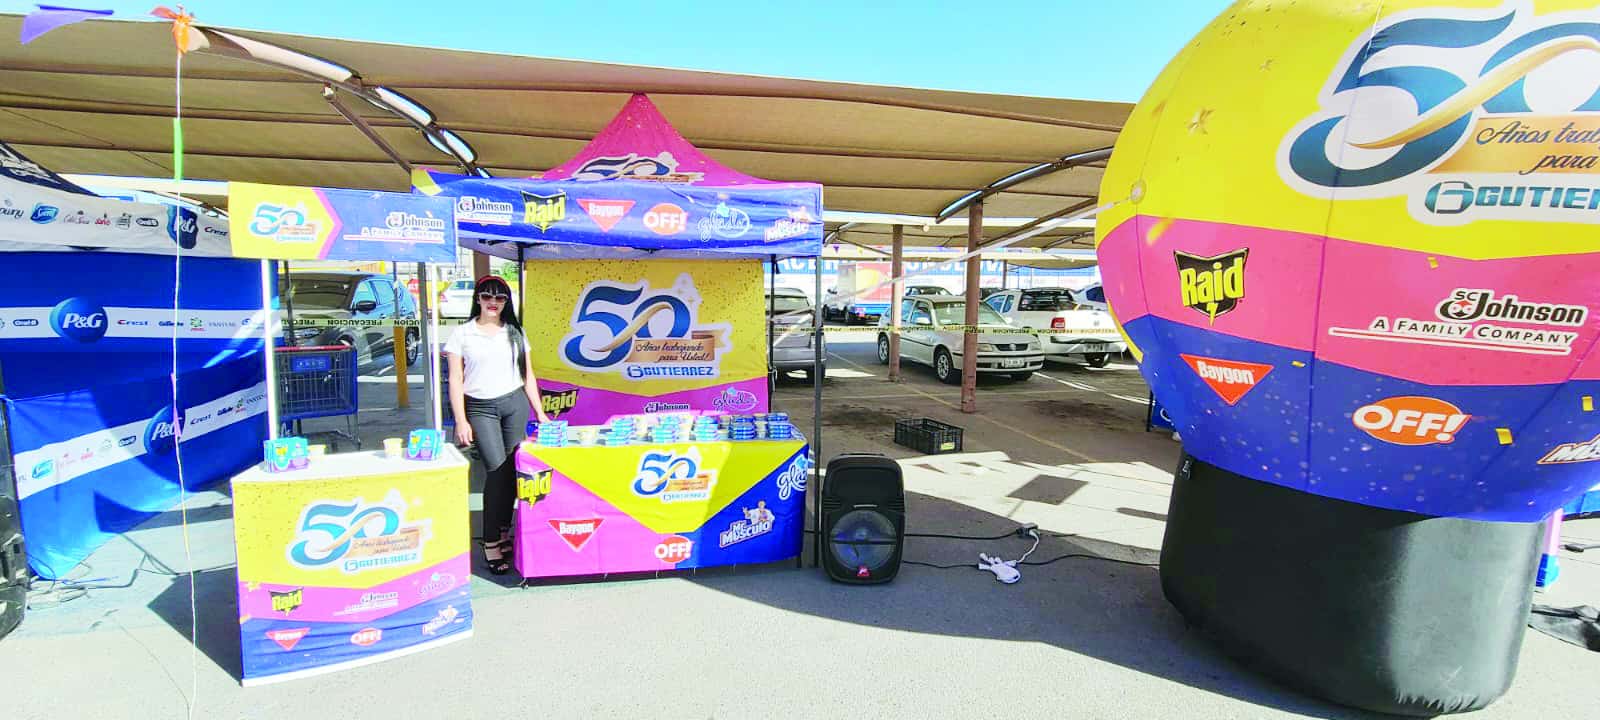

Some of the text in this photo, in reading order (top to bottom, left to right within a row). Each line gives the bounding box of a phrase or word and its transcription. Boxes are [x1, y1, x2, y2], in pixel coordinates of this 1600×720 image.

[1476, 120, 1551, 145] Años
[1518, 154, 1599, 176] para
[250, 204, 304, 235] 50
[388, 212, 443, 228] Johnson
[524, 196, 566, 224] Raid
[643, 211, 688, 232] OFF!
[1180, 257, 1244, 307] Raid
[1440, 292, 1584, 323] Johnson
[1454, 290, 1478, 300] SC
[62, 312, 104, 329] P&G
[564, 285, 691, 368] 50
[1374, 319, 1574, 344] A FAMILY COMPANY
[643, 366, 714, 376] GUTIERREZ
[1196, 360, 1255, 385] Baygon
[541, 390, 578, 413] Raid
[1354, 403, 1471, 443] OFF!
[633, 453, 697, 496] 50
[290, 503, 399, 566] 50
[655, 541, 692, 559] OFF!
